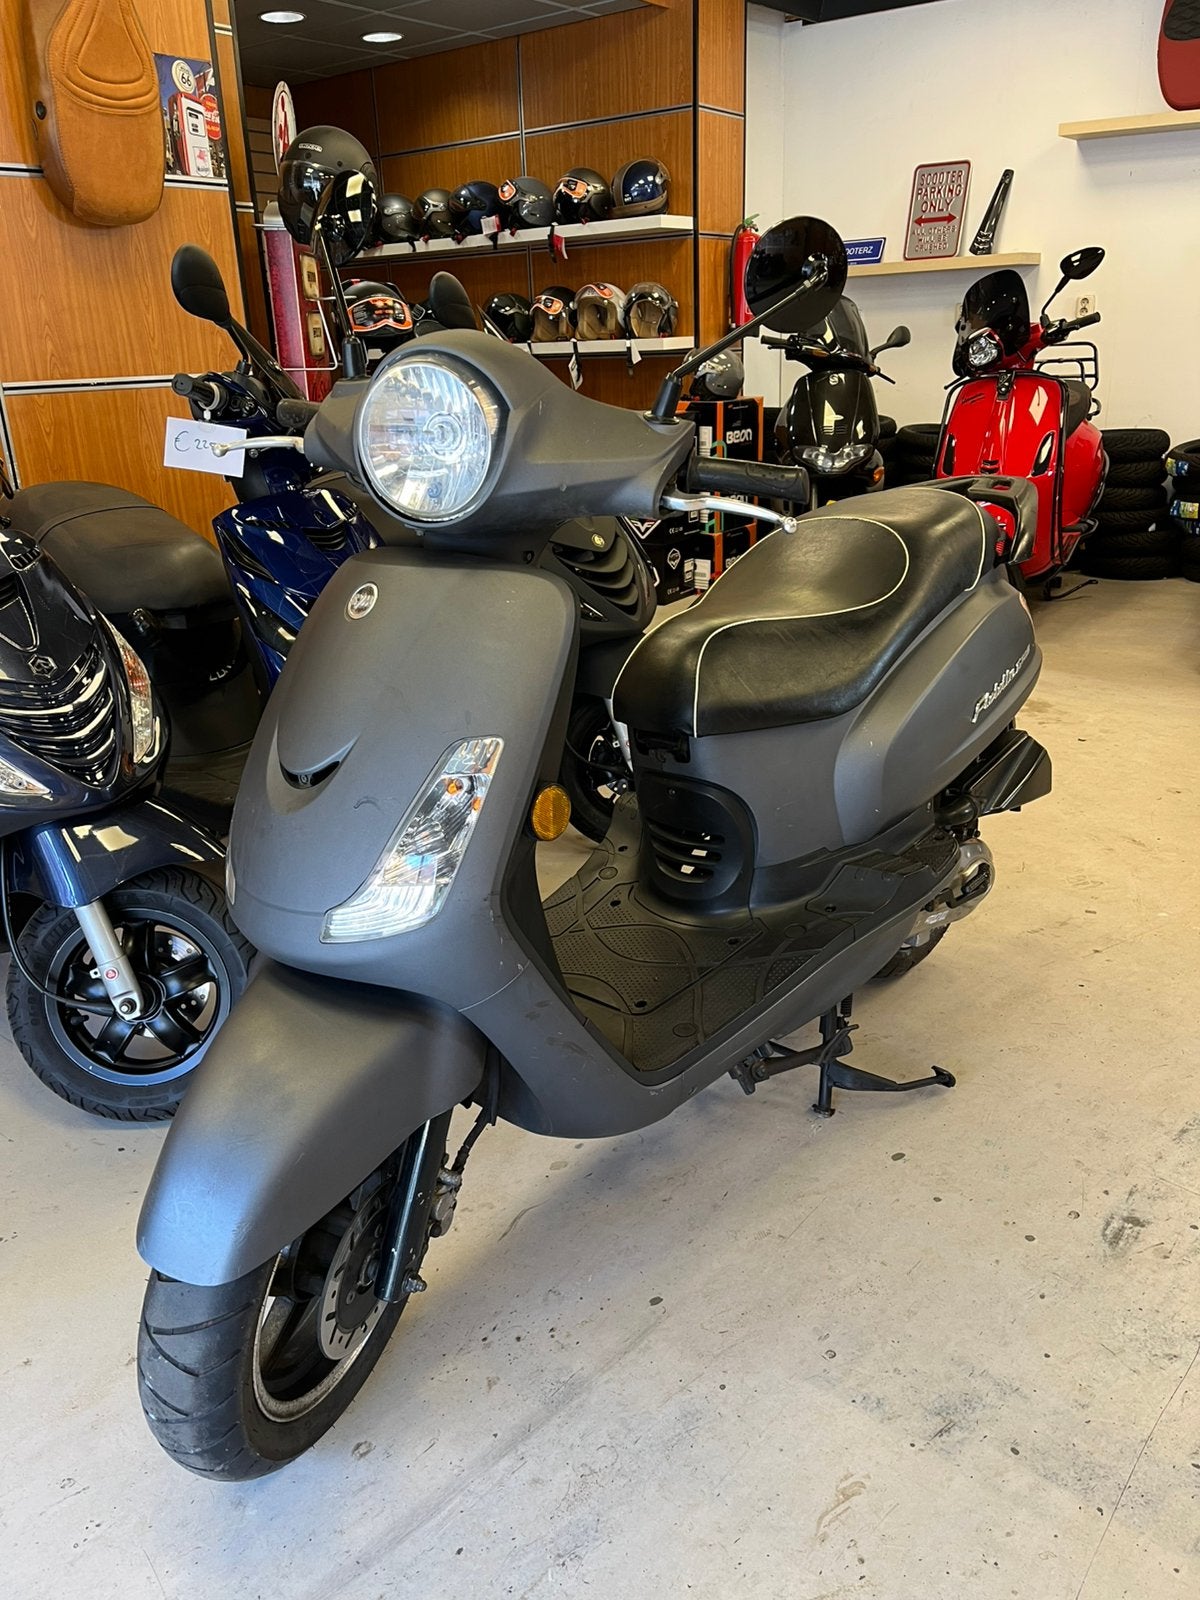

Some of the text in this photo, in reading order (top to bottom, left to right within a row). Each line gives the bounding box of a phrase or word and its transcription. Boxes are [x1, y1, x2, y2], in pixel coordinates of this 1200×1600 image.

[180, 73, 191, 87] 66
[920, 170, 963, 186] SCOOTER
[917, 183, 963, 200] PARKING
[921, 198, 955, 213] ONLY
[912, 225, 957, 236] ALL OTHERS
[914, 243, 948, 252] CRUSHED
[174, 430, 191, 452] €
